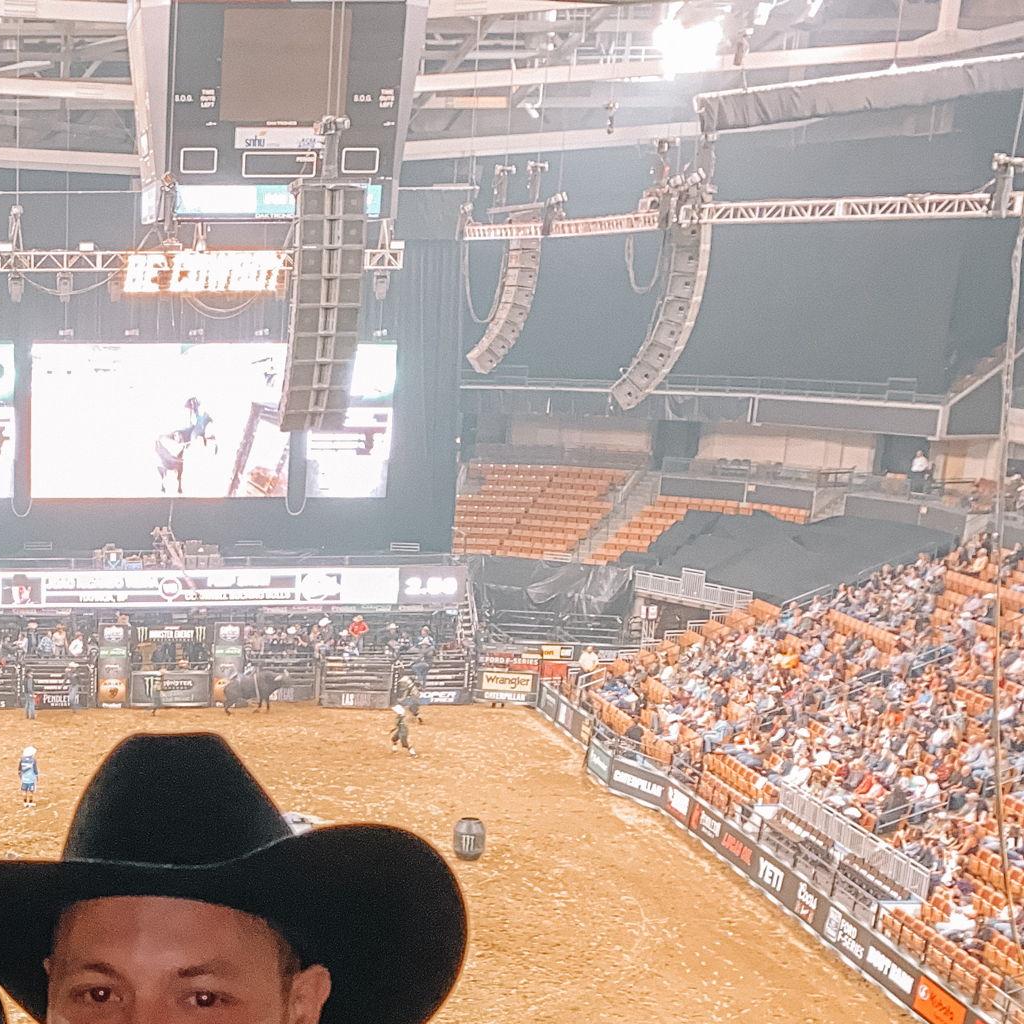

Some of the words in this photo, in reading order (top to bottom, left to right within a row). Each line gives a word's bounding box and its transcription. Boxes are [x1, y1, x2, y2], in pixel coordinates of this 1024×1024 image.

[505, 657, 539, 666] F-SERIES
[485, 674, 530, 689] Wrangler
[43, 694, 80, 704] PENDLETN
[341, 693, 354, 705] LAS
[484, 691, 526, 701] CATERPILLAR
[613, 769, 665, 797] CATERPILLAR
[758, 856, 785, 892] YETI
[840, 918, 858, 936] FORD
[837, 931, 865, 960] F-SERIES
